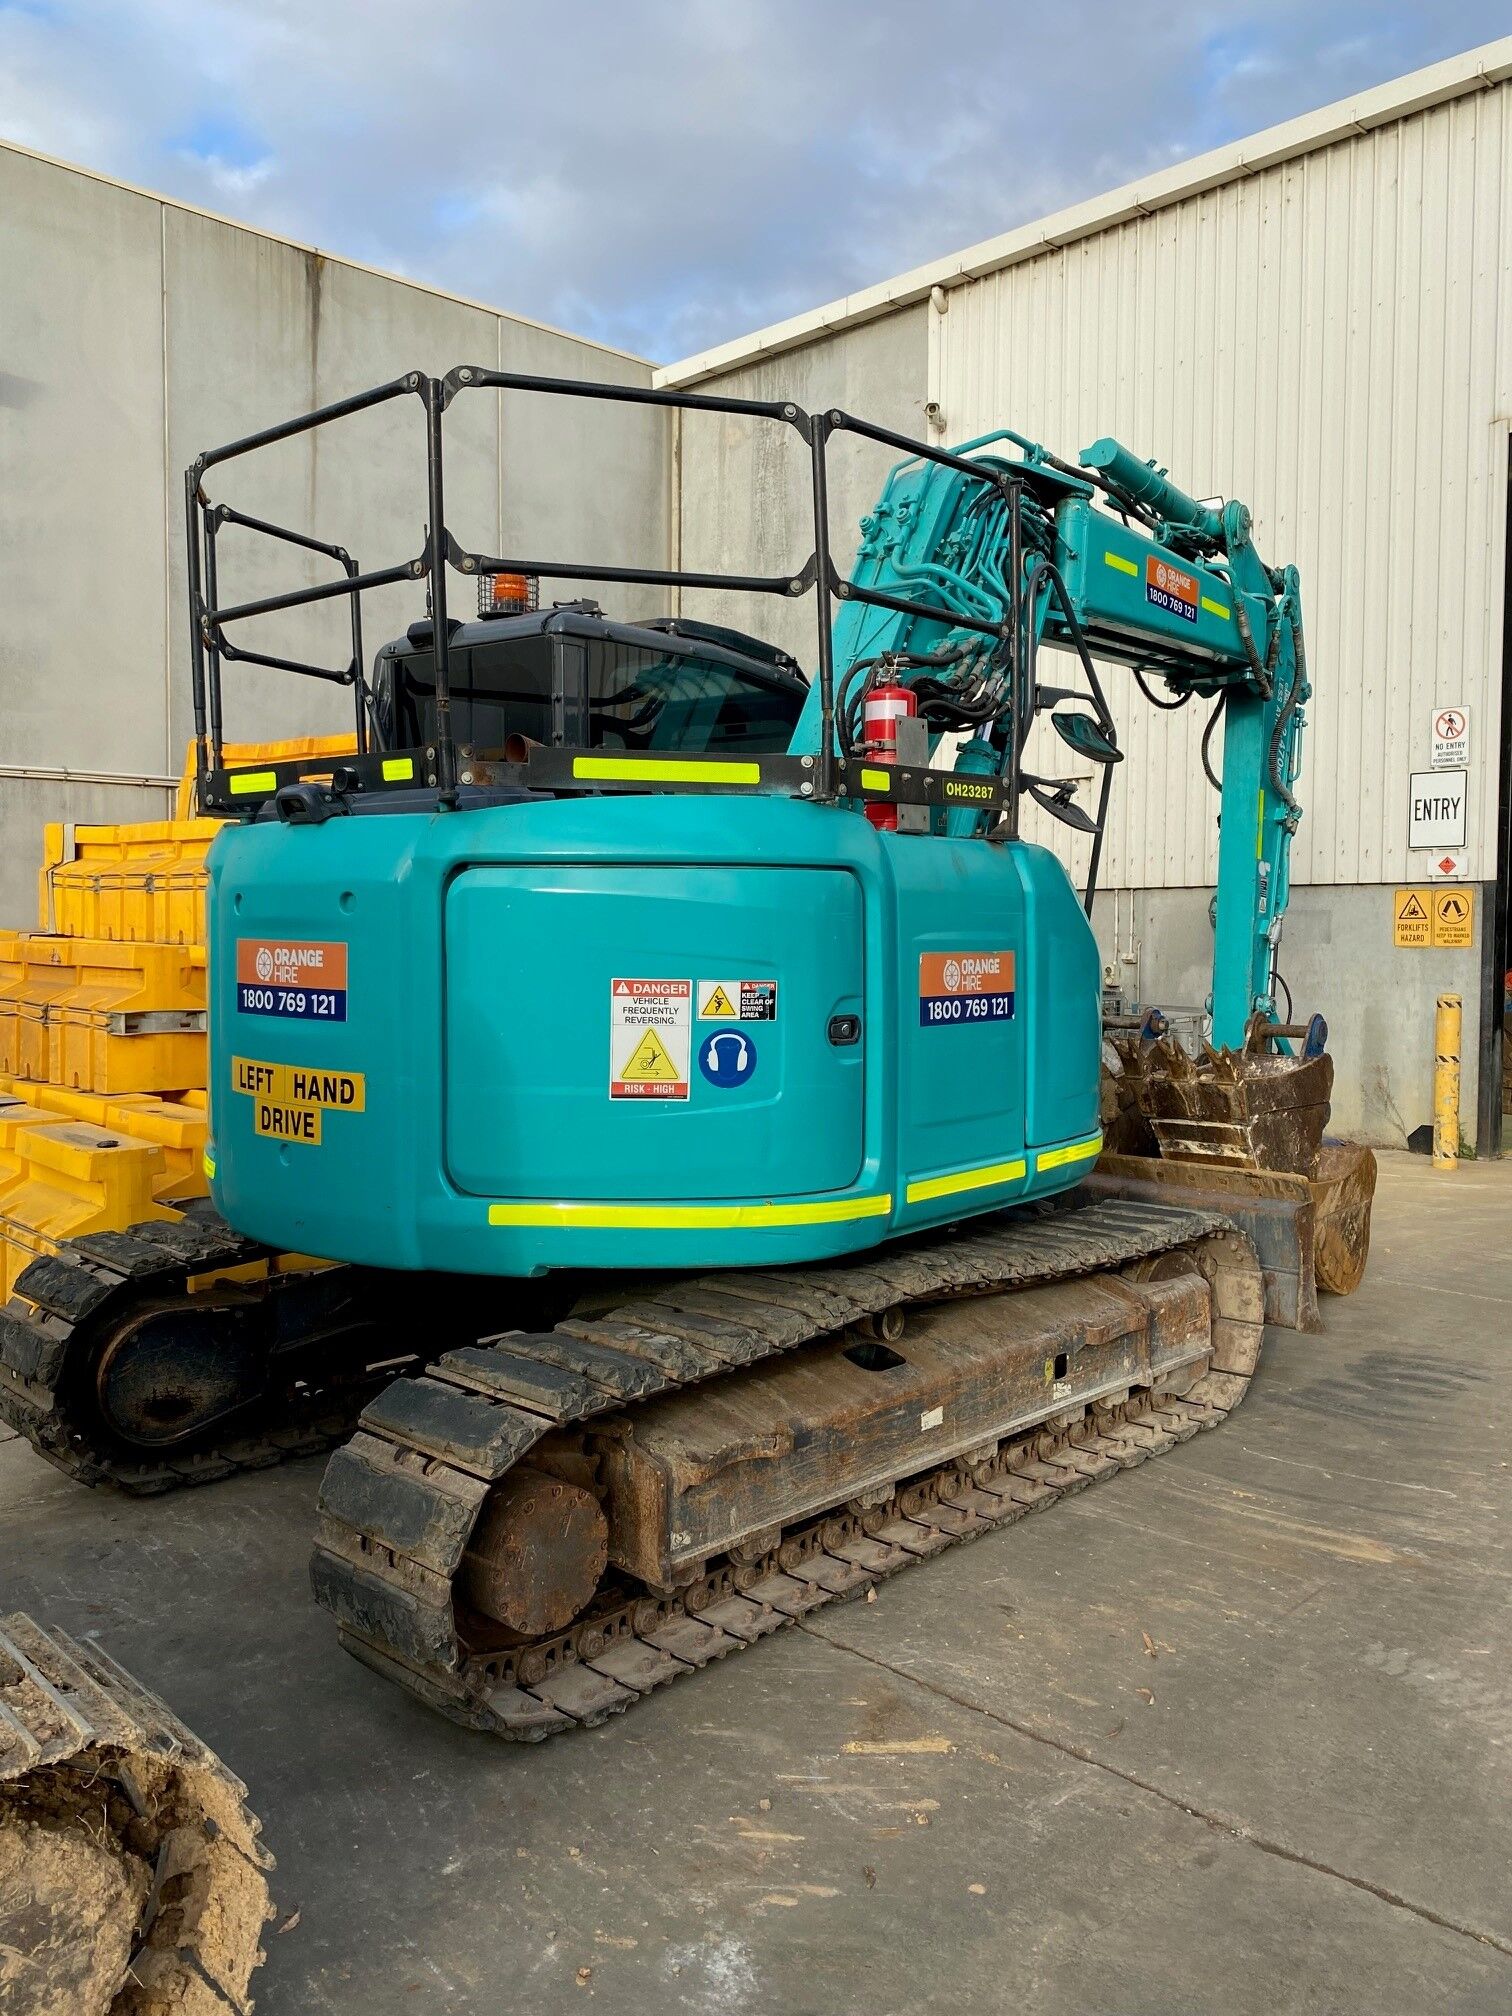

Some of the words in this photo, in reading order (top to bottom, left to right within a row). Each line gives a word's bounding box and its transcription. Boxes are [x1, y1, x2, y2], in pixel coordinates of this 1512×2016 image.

[1167, 569, 1191, 589] ORANGE
[1167, 581, 1180, 596] HIRE
[1150, 588, 1168, 606] 1800
[1170, 597, 1183, 614] 769
[1184, 605, 1195, 619] 121
[1446, 741, 1465, 749] ENTRY
[946, 782, 994, 799] OH23287
[1414, 797, 1461, 821] ENTRY
[1397, 924, 1429, 932] FORKLIFTS
[1401, 934, 1425, 942] HAZARD
[274, 948, 324, 967] ORANGE
[962, 958, 1000, 975] ORANGE
[274, 967, 299, 984] HIRE
[962, 975, 982, 991] HIRE
[633, 984, 688, 994] DANGER
[242, 989, 273, 1009] 1800
[278, 992, 306, 1013] 769
[311, 994, 335, 1014] 121
[632, 997, 669, 1005] VEHICLE
[928, 1000, 961, 1020] 1800
[965, 999, 988, 1018] 769
[992, 997, 1008, 1015] 121
[622, 1007, 679, 1015] FREQUENTLY
[624, 1016, 677, 1025] REVERSING.
[239, 1064, 274, 1093] LEFT
[293, 1073, 355, 1104] HAND
[624, 1084, 645, 1094] RISK
[653, 1084, 675, 1094] HIGH
[261, 1105, 315, 1138] DRIVE
